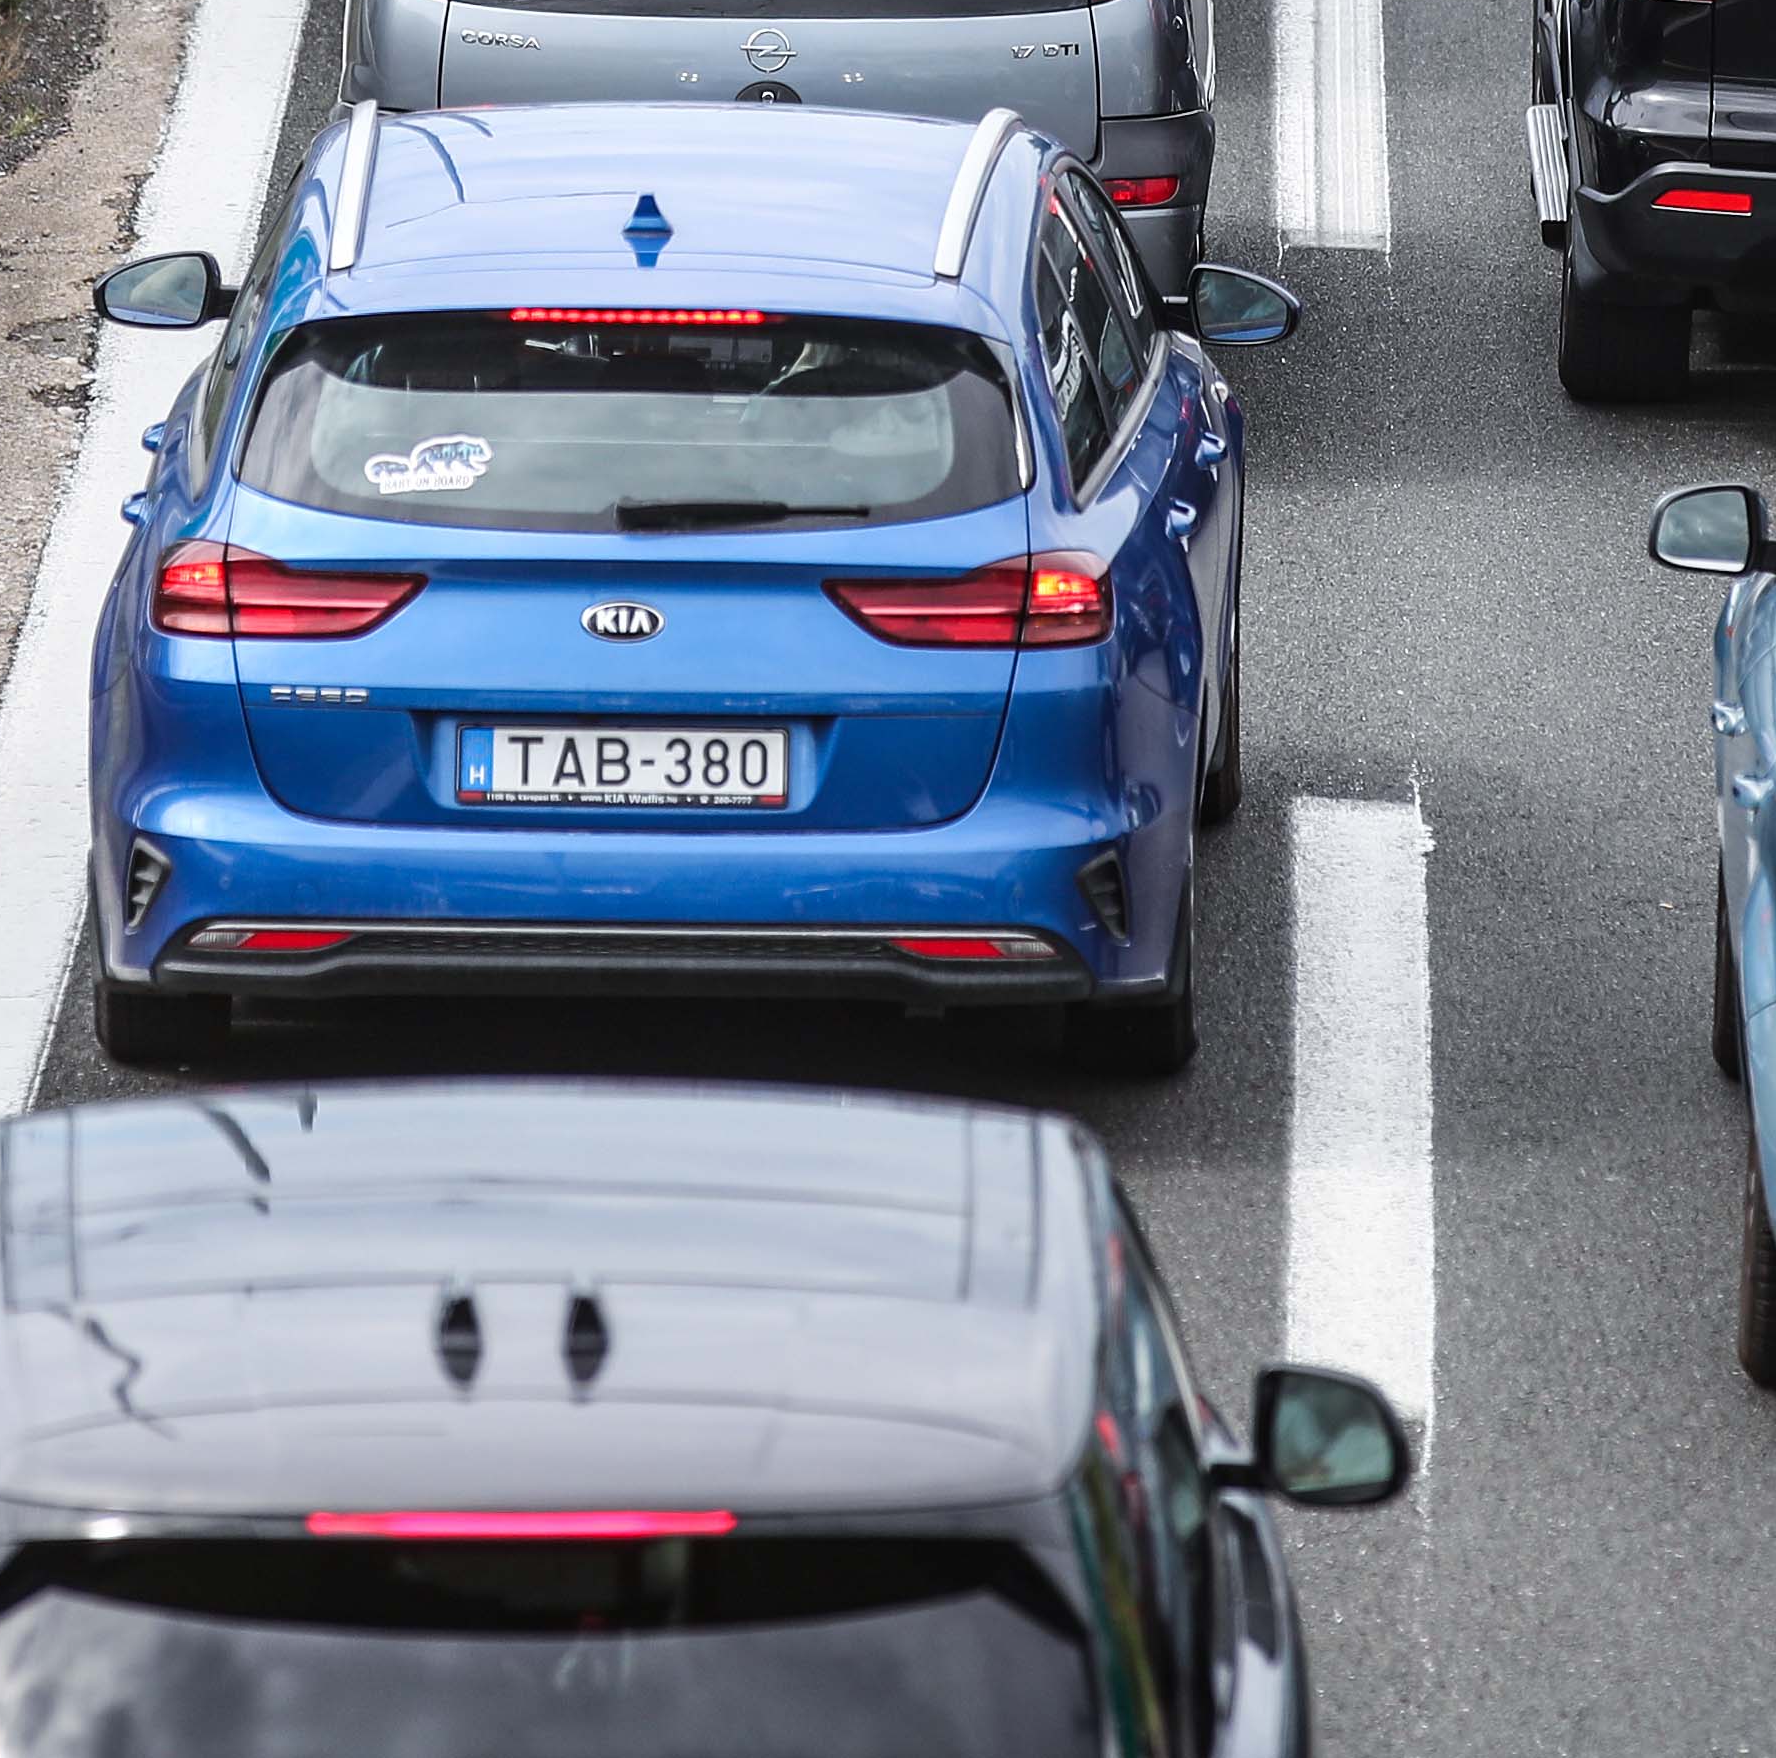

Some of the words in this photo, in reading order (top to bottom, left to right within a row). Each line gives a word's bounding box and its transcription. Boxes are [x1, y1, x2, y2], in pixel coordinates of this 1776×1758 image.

[461, 28, 542, 51] CORSA
[1042, 42, 1080, 58] DTI
[596, 608, 652, 634] KIA
[508, 735, 768, 789] TAB-380
[469, 764, 485, 786] H
